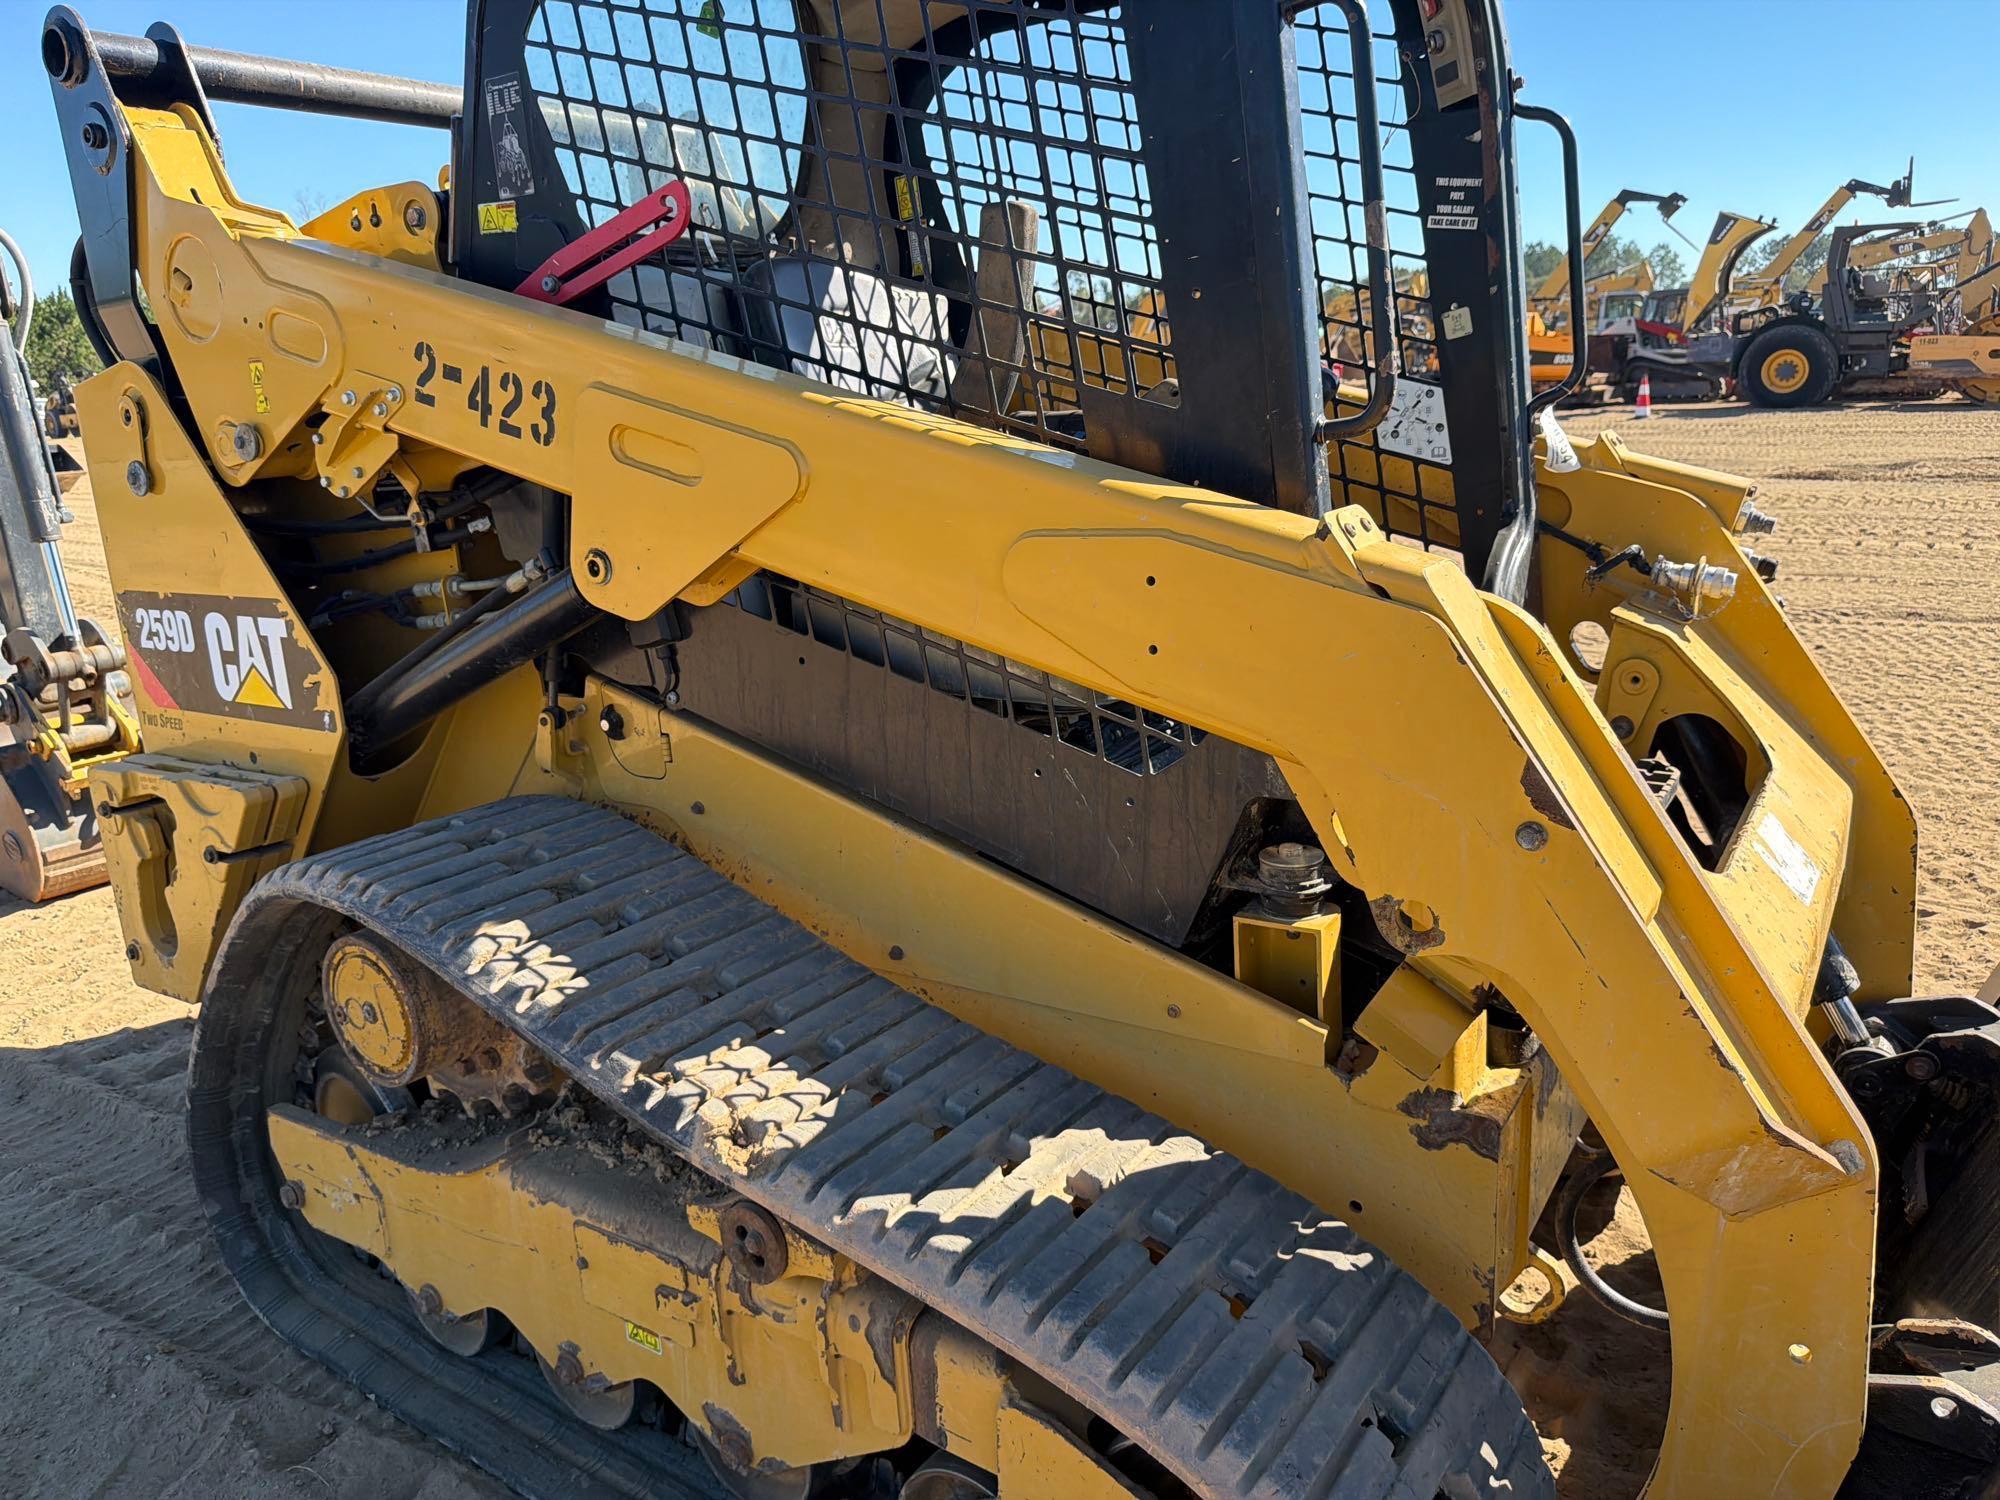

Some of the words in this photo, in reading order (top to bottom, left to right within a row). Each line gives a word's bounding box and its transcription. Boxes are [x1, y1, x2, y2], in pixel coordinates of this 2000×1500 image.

[1436, 177, 1449, 186] THIS
[1450, 178, 1482, 187] EQUIPMENT
[1450, 191, 1465, 200] PAYS
[1437, 205, 1452, 213] YOUR
[1453, 205, 1475, 214] SALARY
[1431, 218, 1443, 226] TAKE
[1445, 218, 1460, 227] CARE
[1461, 219, 1469, 227] OF
[1469, 219, 1476, 227] IT
[1898, 242, 1914, 255] CAT
[414, 341, 556, 447] 2-423
[135, 607, 196, 653] 259D
[204, 611, 293, 710] CAT
